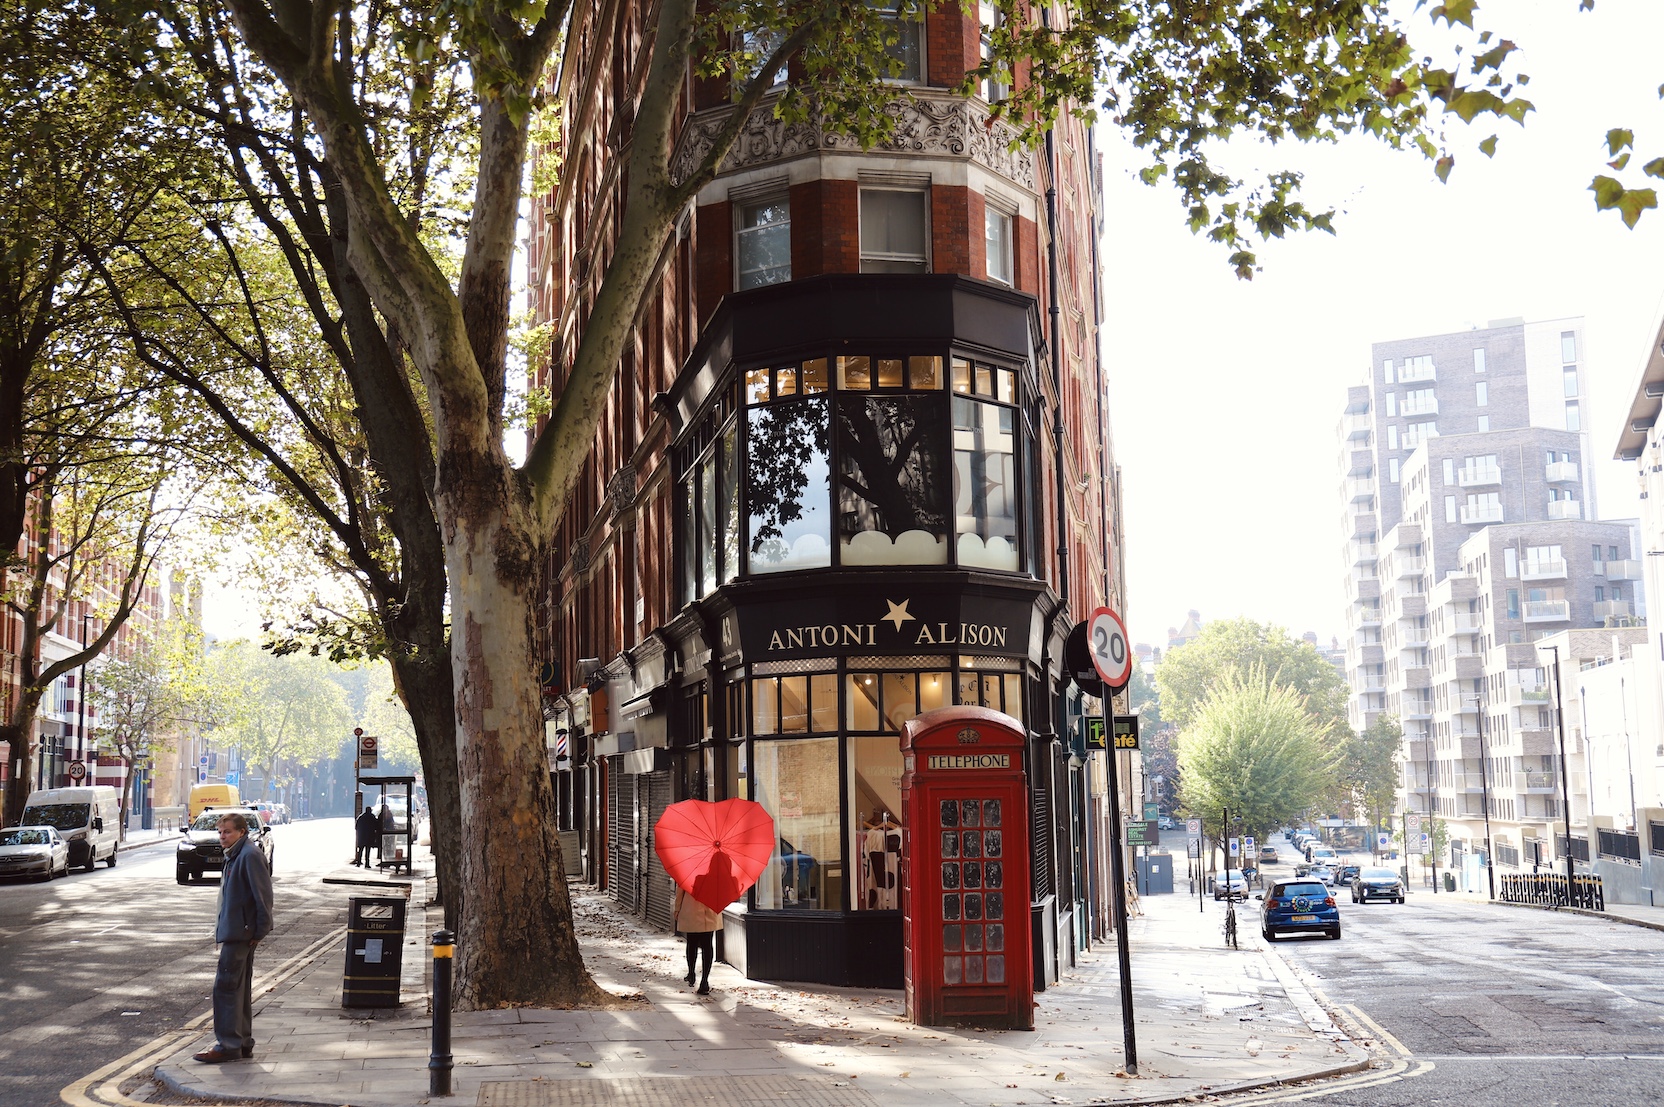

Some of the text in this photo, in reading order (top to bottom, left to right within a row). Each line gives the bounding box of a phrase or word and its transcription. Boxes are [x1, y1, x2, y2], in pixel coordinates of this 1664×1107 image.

[722, 616, 732, 648] 43
[768, 622, 1008, 651] ANTONI ALISON
[1094, 625, 1125, 664] 20
[71, 766, 83, 775] 20
[929, 754, 1010, 769] TELEPHONE
